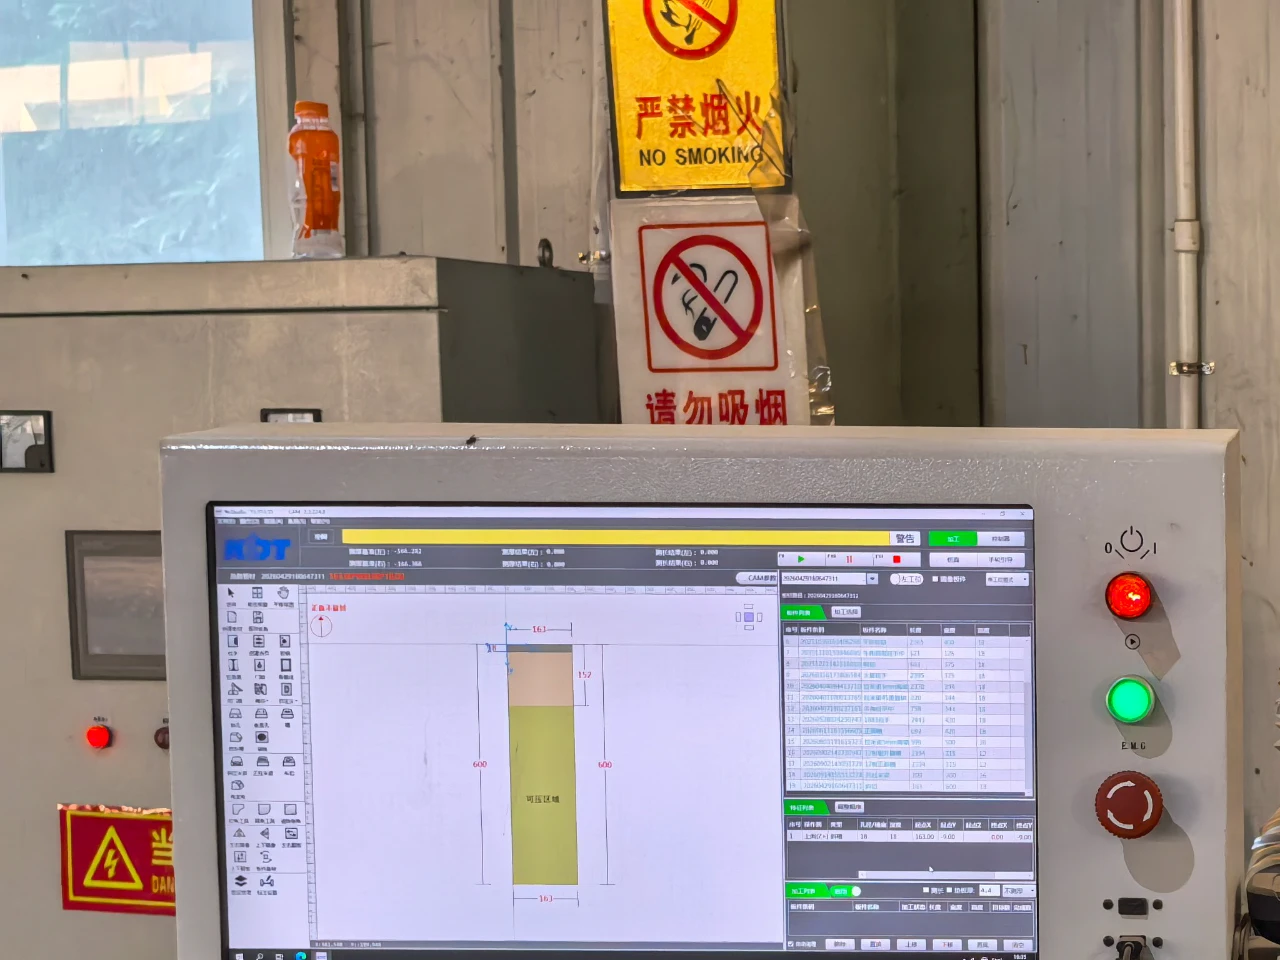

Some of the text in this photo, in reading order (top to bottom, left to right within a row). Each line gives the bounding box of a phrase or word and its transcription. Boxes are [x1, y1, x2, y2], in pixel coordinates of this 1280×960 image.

[635, 91, 763, 139] 严禁烟火
[640, 146, 764, 166] NO SMOKING
[646, 388, 788, 425] 请勿吸烟
[896, 534, 915, 544] 警告
